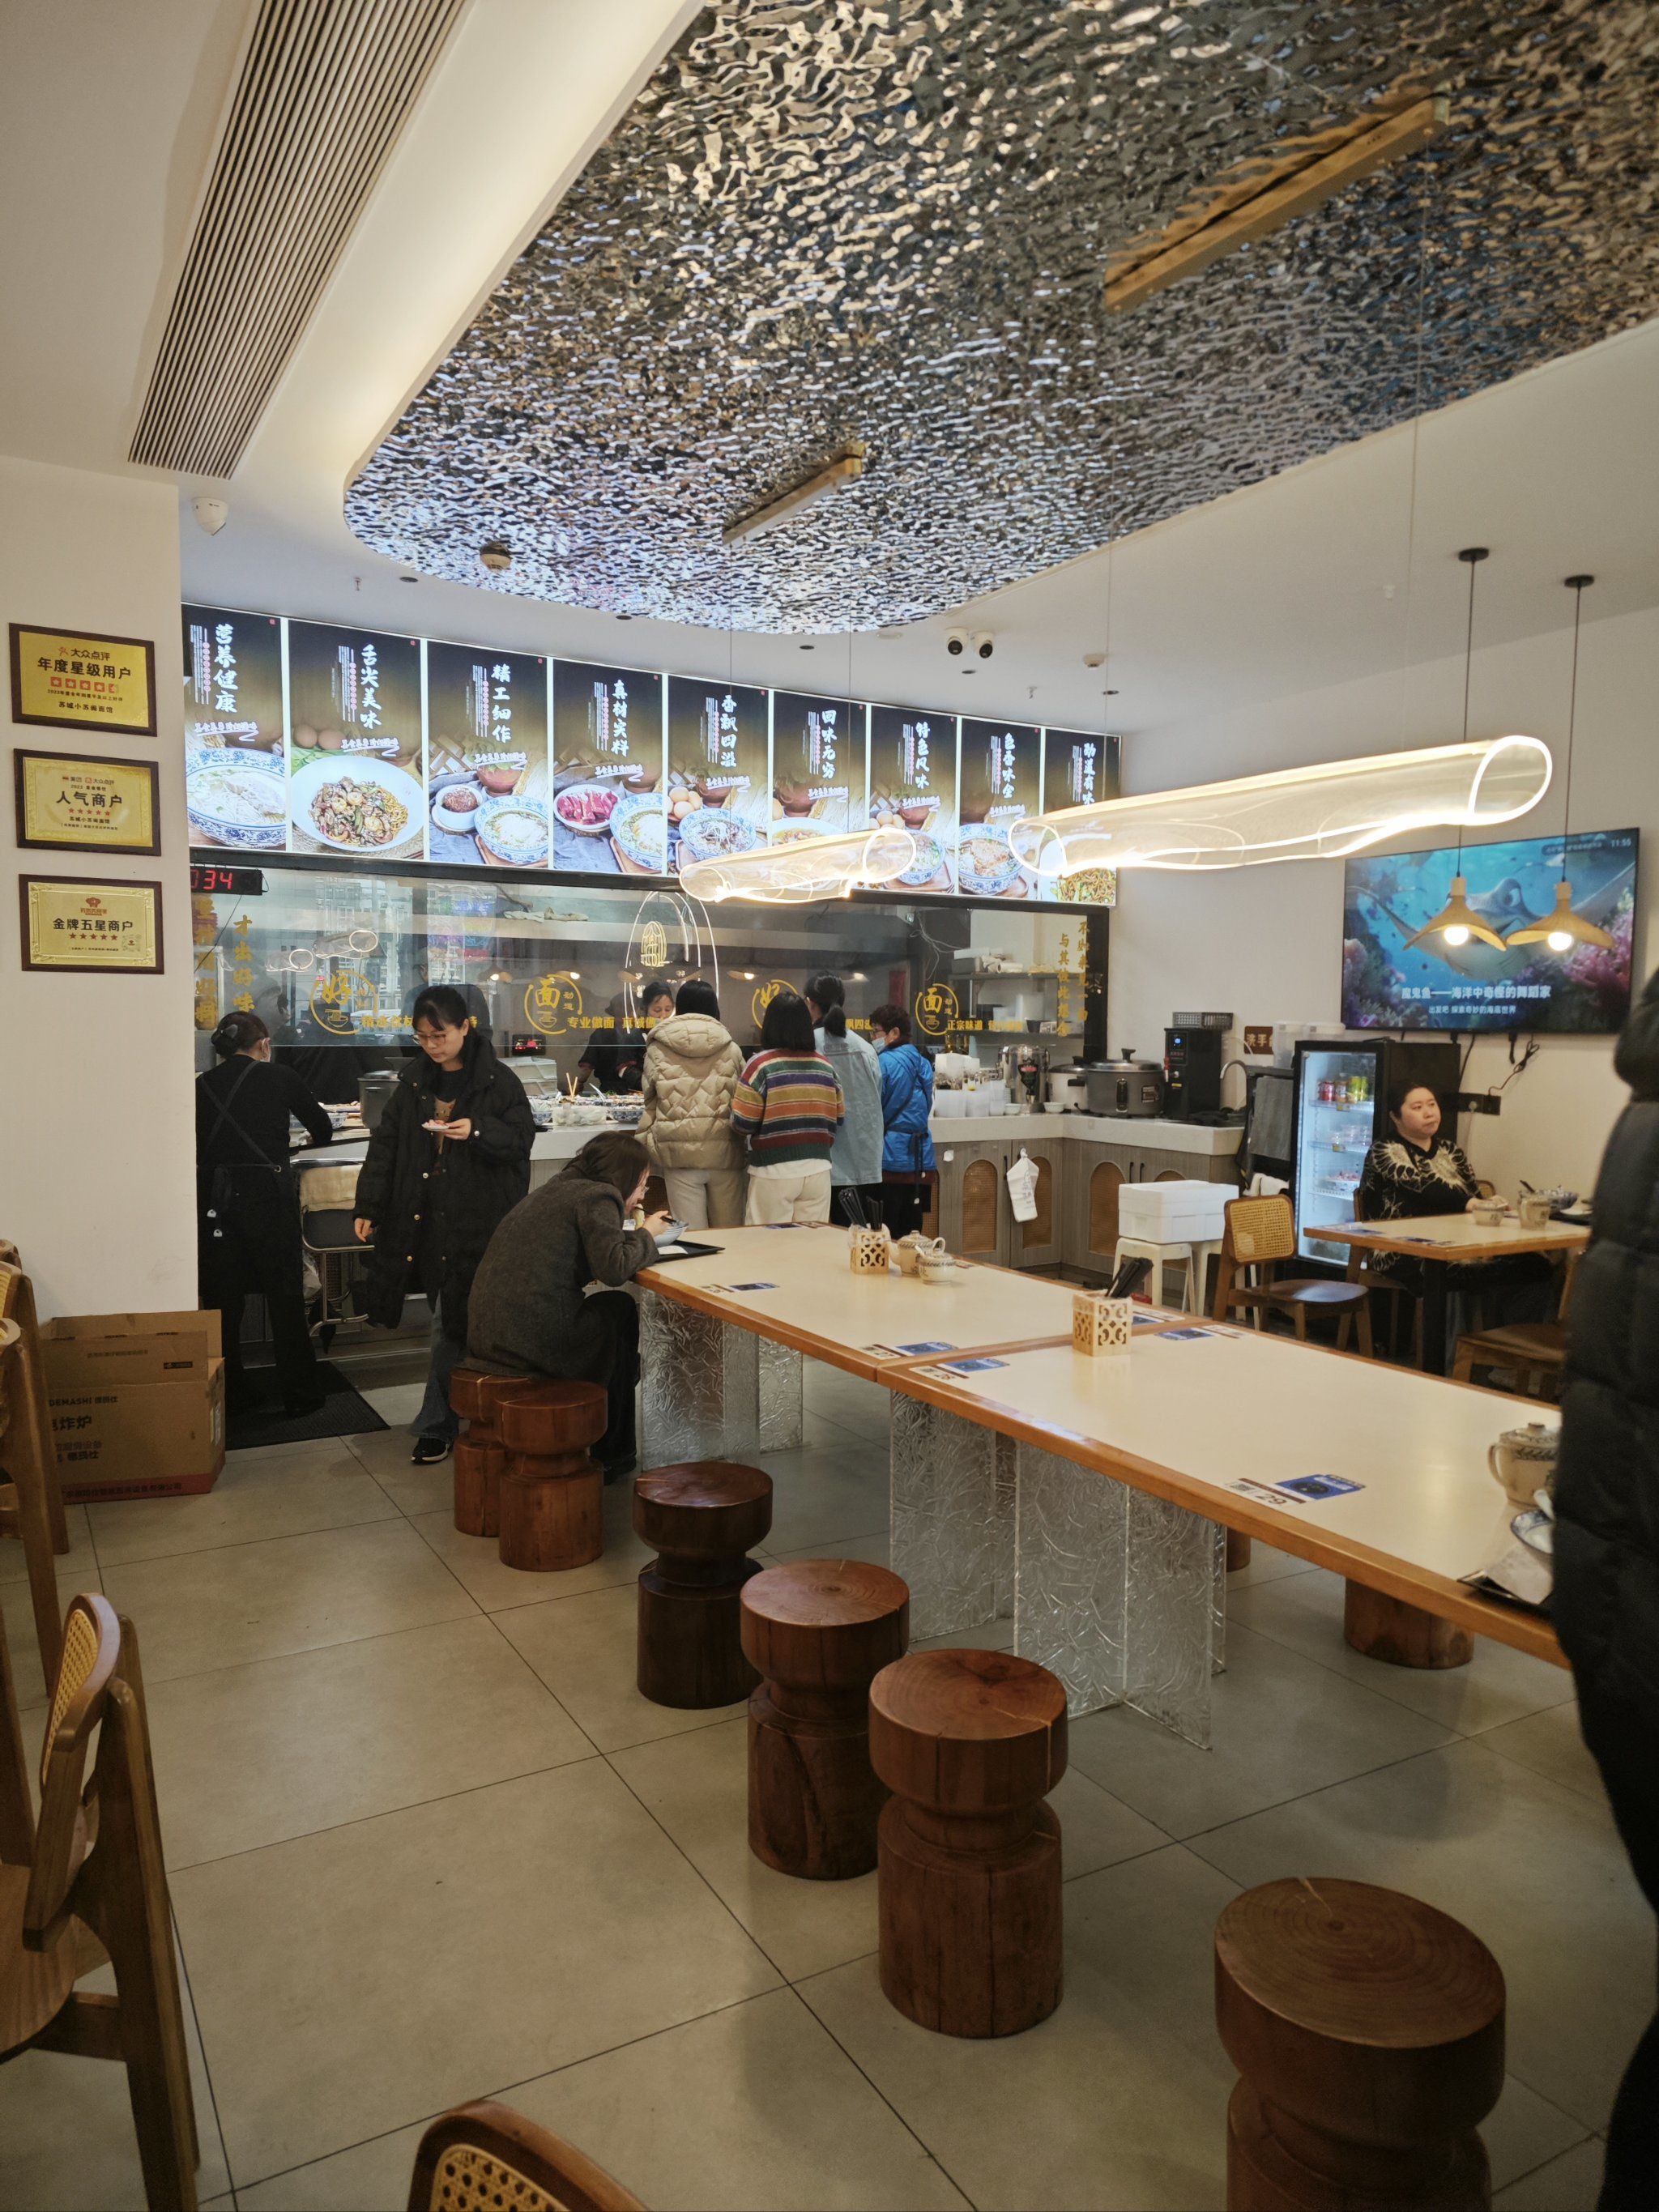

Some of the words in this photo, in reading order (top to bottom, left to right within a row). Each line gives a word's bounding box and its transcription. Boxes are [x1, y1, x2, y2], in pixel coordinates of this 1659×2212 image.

[37, 657, 130, 679] 年度星级用户
[71, 648, 110, 661] 大众点评
[213, 623, 238, 713] 营养健康
[359, 643, 382, 730] 舌尖美味
[491, 663, 512, 744] 精工细作
[611, 680, 629, 757] 真材实料
[720, 694, 738, 768] 香飘四溢
[821, 709, 838, 780] 回味无穷
[915, 721, 931, 790] 特色风味
[1002, 732, 1016, 799] 色香味全
[56, 791, 122, 808] 人气商户
[53, 918, 133, 932] 金牌五星商户
[322, 973, 352, 1005] 好
[535, 978, 561, 1009] 面
[923, 987, 943, 1013] 面
[568, 1016, 615, 1029] 专业做面
[948, 1019, 983, 1031] 正宗味道
[49, 1396, 92, 1407] DEMASHI
